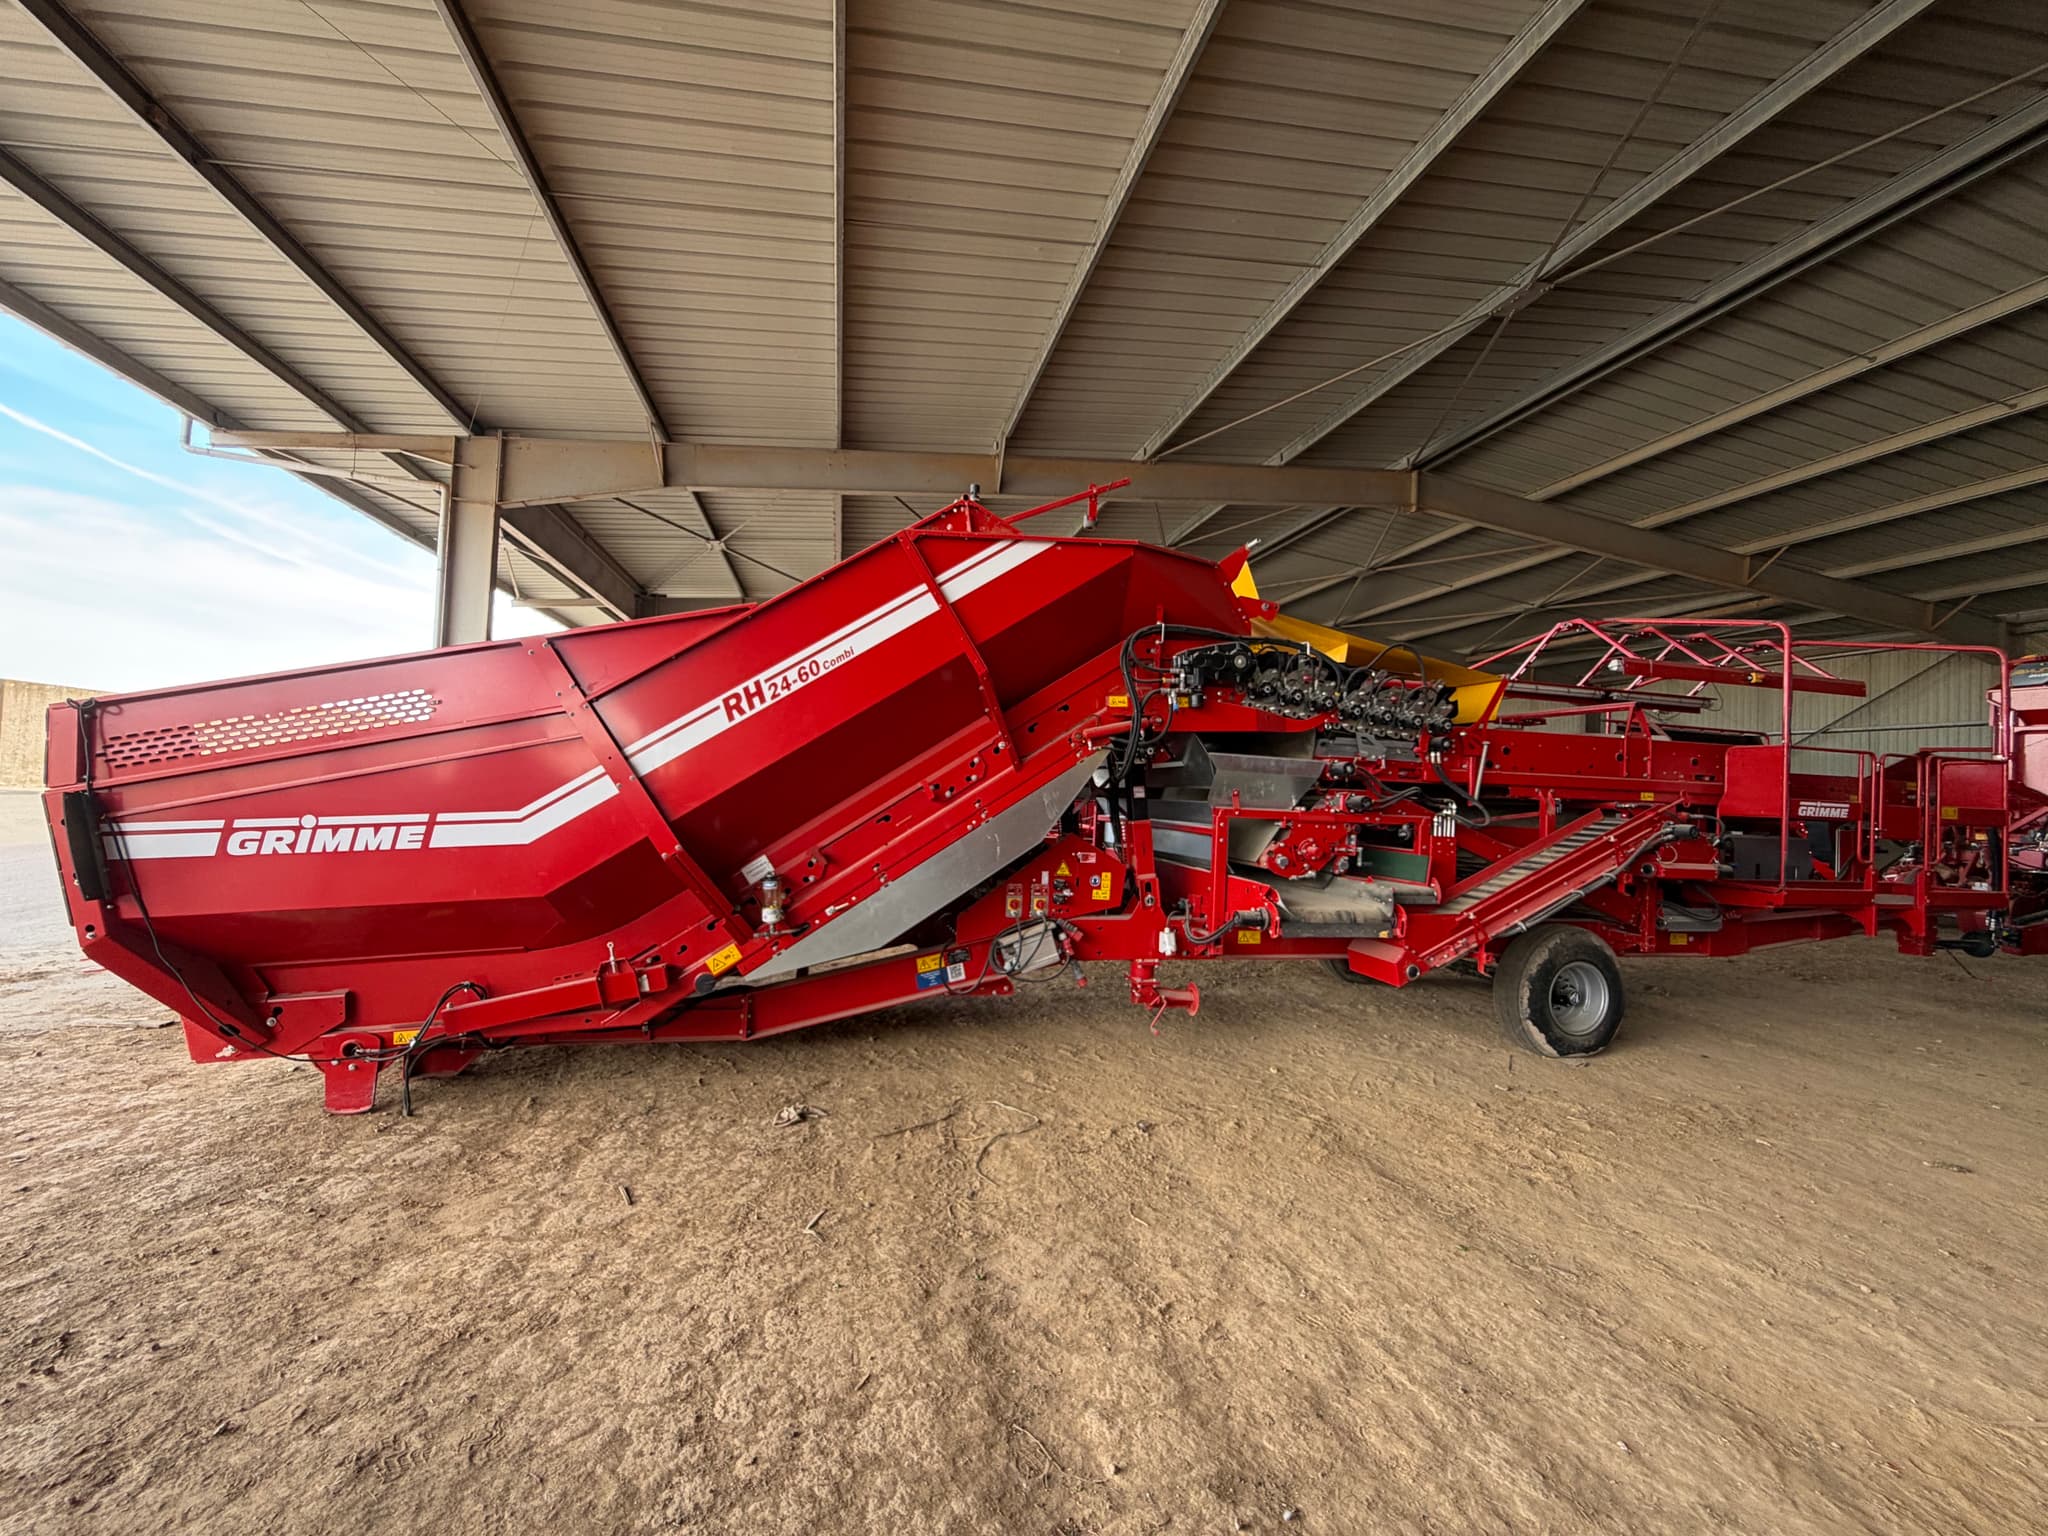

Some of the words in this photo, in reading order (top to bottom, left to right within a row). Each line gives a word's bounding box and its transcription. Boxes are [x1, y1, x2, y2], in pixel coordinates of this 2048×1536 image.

[722, 679, 766, 723] RH
[768, 659, 820, 700] 24-60
[823, 646, 855, 670] Combi
[1798, 801, 1850, 818] GRIMME
[227, 814, 426, 856] GRIMME
